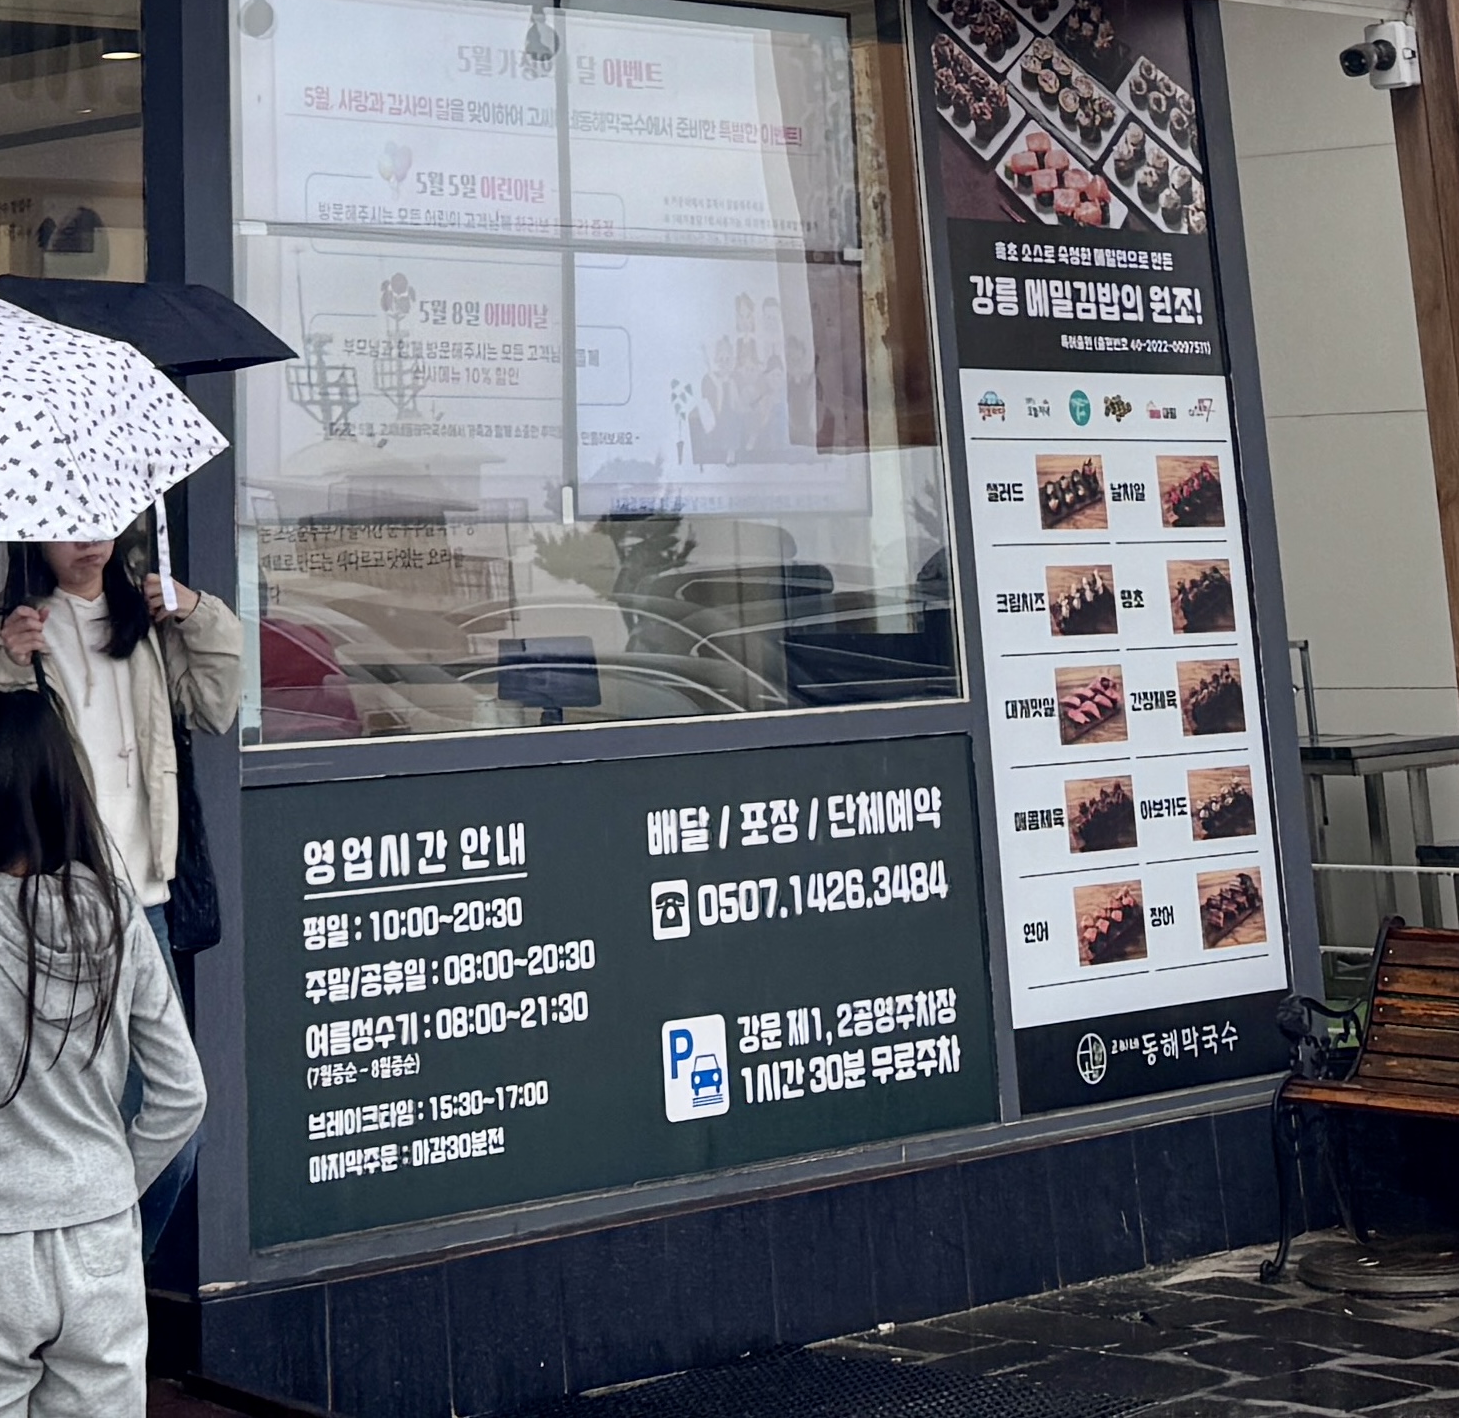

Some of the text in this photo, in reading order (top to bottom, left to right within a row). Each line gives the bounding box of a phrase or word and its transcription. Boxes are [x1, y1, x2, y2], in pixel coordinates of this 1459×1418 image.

[603, 59, 664, 89] 이벤트
[339, 88, 384, 114] 사랑과
[388, 94, 432, 118] 감사의
[436, 97, 465, 122] 달을
[468, 100, 523, 126] 맞이하여
[676, 117, 716, 140] 준비한
[719, 120, 758, 144] 특별한
[416, 172, 545, 203] 5월 5일 어린이날
[318, 201, 392, 225] 방문해주시는
[425, 208, 461, 229] 어린이
[1021, 244, 1055, 264] 소스로
[1057, 247, 1092, 267] 숙성한
[1151, 252, 1174, 272] 만든
[419, 300, 549, 329] 5월 8일 어버이날
[969, 275, 1204, 325] 강릉 메밀김밥의 원조!
[426, 340, 499, 361] 방문해주시는
[501, 343, 523, 362] 모든
[465, 366, 492, 385] 10%
[495, 366, 519, 386] 할인
[985, 482, 1024, 503] 샐러드
[996, 592, 1046, 614] 크림치즈
[1129, 690, 1178, 712] 간장제육
[646, 805, 710, 856] 배달
[739, 798, 800, 847] 포장
[827, 785, 942, 840] 단체예약
[1140, 796, 1188, 821] 아보카도
[303, 821, 526, 886] 영업시간 안내
[696, 860, 949, 928] 0507.1426.3484
[302, 915, 350, 951] 평일
[368, 896, 523, 943] 10:00~20:30
[1023, 905, 1175, 944] 연어 장어
[305, 957, 427, 1004] 주말/공휴일
[443, 939, 596, 987] 08:00~20:30
[306, 1011, 418, 1060] 여름성수기
[435, 990, 589, 1041] 08:00~21:30
[737, 1011, 783, 1054] 강문
[836, 987, 957, 1039] 2공영주차장
[1141, 1020, 1240, 1066] 동해막국수
[740, 1034, 961, 1105] 1시간 30분 무료주차
[308, 1098, 415, 1141] 브레이크타임
[429, 1079, 550, 1123] 15:30~17:00
[309, 1144, 399, 1184] 마지막주문
[411, 1126, 506, 1167] 마감30분전
